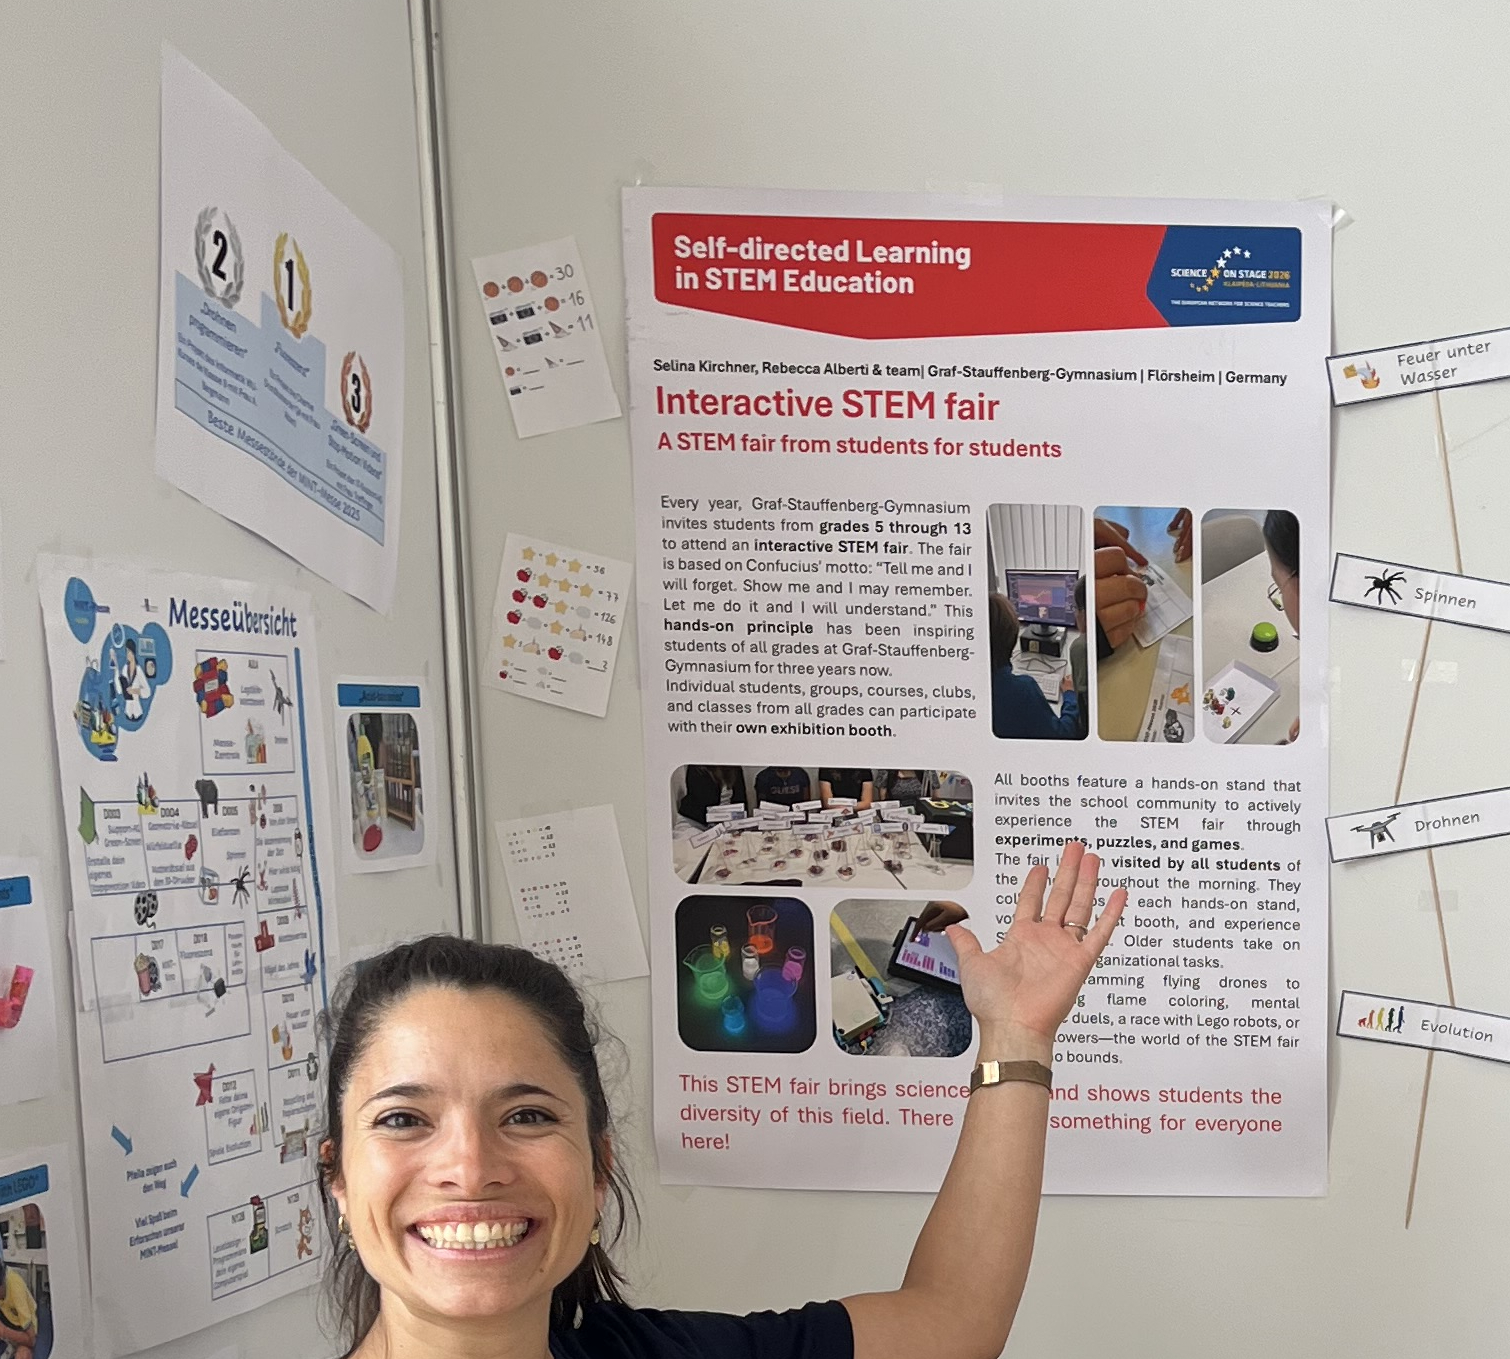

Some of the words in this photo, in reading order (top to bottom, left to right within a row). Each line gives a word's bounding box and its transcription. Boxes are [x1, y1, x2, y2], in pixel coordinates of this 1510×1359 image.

[212, 230, 228, 281] 2
[675, 236, 849, 265] Self-directed
[857, 240, 971, 269] Learning
[555, 263, 574, 281] 30
[676, 266, 699, 289] in
[706, 268, 776, 291] STEM
[784, 269, 914, 293] Education
[1171, 268, 1207, 278] SCIENCE
[1223, 269, 1237, 278] ON
[1238, 269, 1267, 279] STAGE
[285, 259, 294, 312] 1
[568, 289, 585, 306] 16
[1397, 350, 1441, 368] Feuer
[1447, 341, 1492, 359] unter
[654, 359, 695, 372] Selina
[699, 360, 758, 375] Kirchner,
[762, 361, 820, 374] Rebecca
[824, 363, 869, 375] Alberti
[872, 364, 882, 376] &
[886, 365, 924, 379] team|
[928, 365, 1136, 382] Graf-Stauffenberg-Gymnasium
[1141, 369, 1143, 384] |
[1148, 369, 1215, 382] Flörsheim
[1219, 371, 1221, 385] |
[1226, 371, 1287, 386] Germany
[1400, 366, 1458, 386] Wasser
[352, 373, 361, 414] 3
[657, 386, 832, 417] Interactive
[843, 390, 934, 418] STEM
[945, 392, 1000, 420] fair
[658, 432, 673, 450] A
[677, 432, 735, 451] STEM
[741, 433, 776, 452] fair
[780, 434, 830, 453] from
[837, 437, 928, 454] students
[934, 437, 964, 455] for
[970, 439, 1061, 457] students
[661, 495, 699, 511] Every
[708, 499, 742, 512] year,
[752, 497, 970, 515] Graf-Stauffenberg-Gymnasium
[662, 518, 707, 529] invites
[713, 518, 775, 531] students
[781, 519, 813, 531] from
[820, 520, 869, 535] grades
[875, 521, 883, 533] 5
[889, 521, 947, 537] through
[954, 522, 971, 535] 13
[662, 538, 676, 549] to
[682, 538, 726, 550] attend
[732, 541, 749, 551] an
[755, 539, 833, 552] interactive
[838, 540, 878, 553] STEM
[883, 541, 908, 554] fair.
[918, 542, 943, 555] The
[949, 543, 971, 555] fair
[1414, 587, 1477, 609] Spinnen
[168, 597, 298, 638] Messeübersicht
[1414, 811, 1480, 832] Drohnen
[1097, 836, 1188, 850] and
[1192, 840, 1242, 852] games.
[1420, 1019, 1494, 1043] Evolution
[679, 1074, 718, 1092] This
[727, 1076, 781, 1093] STEM
[789, 1078, 820, 1095] fair
[829, 1078, 886, 1100] brings
[895, 1081, 971, 1100] science
[1088, 1085, 1150, 1102] shows
[1159, 1087, 1242, 1104] students
[1251, 1088, 1281, 1104] the
[682, 1133, 729, 1149] here!
